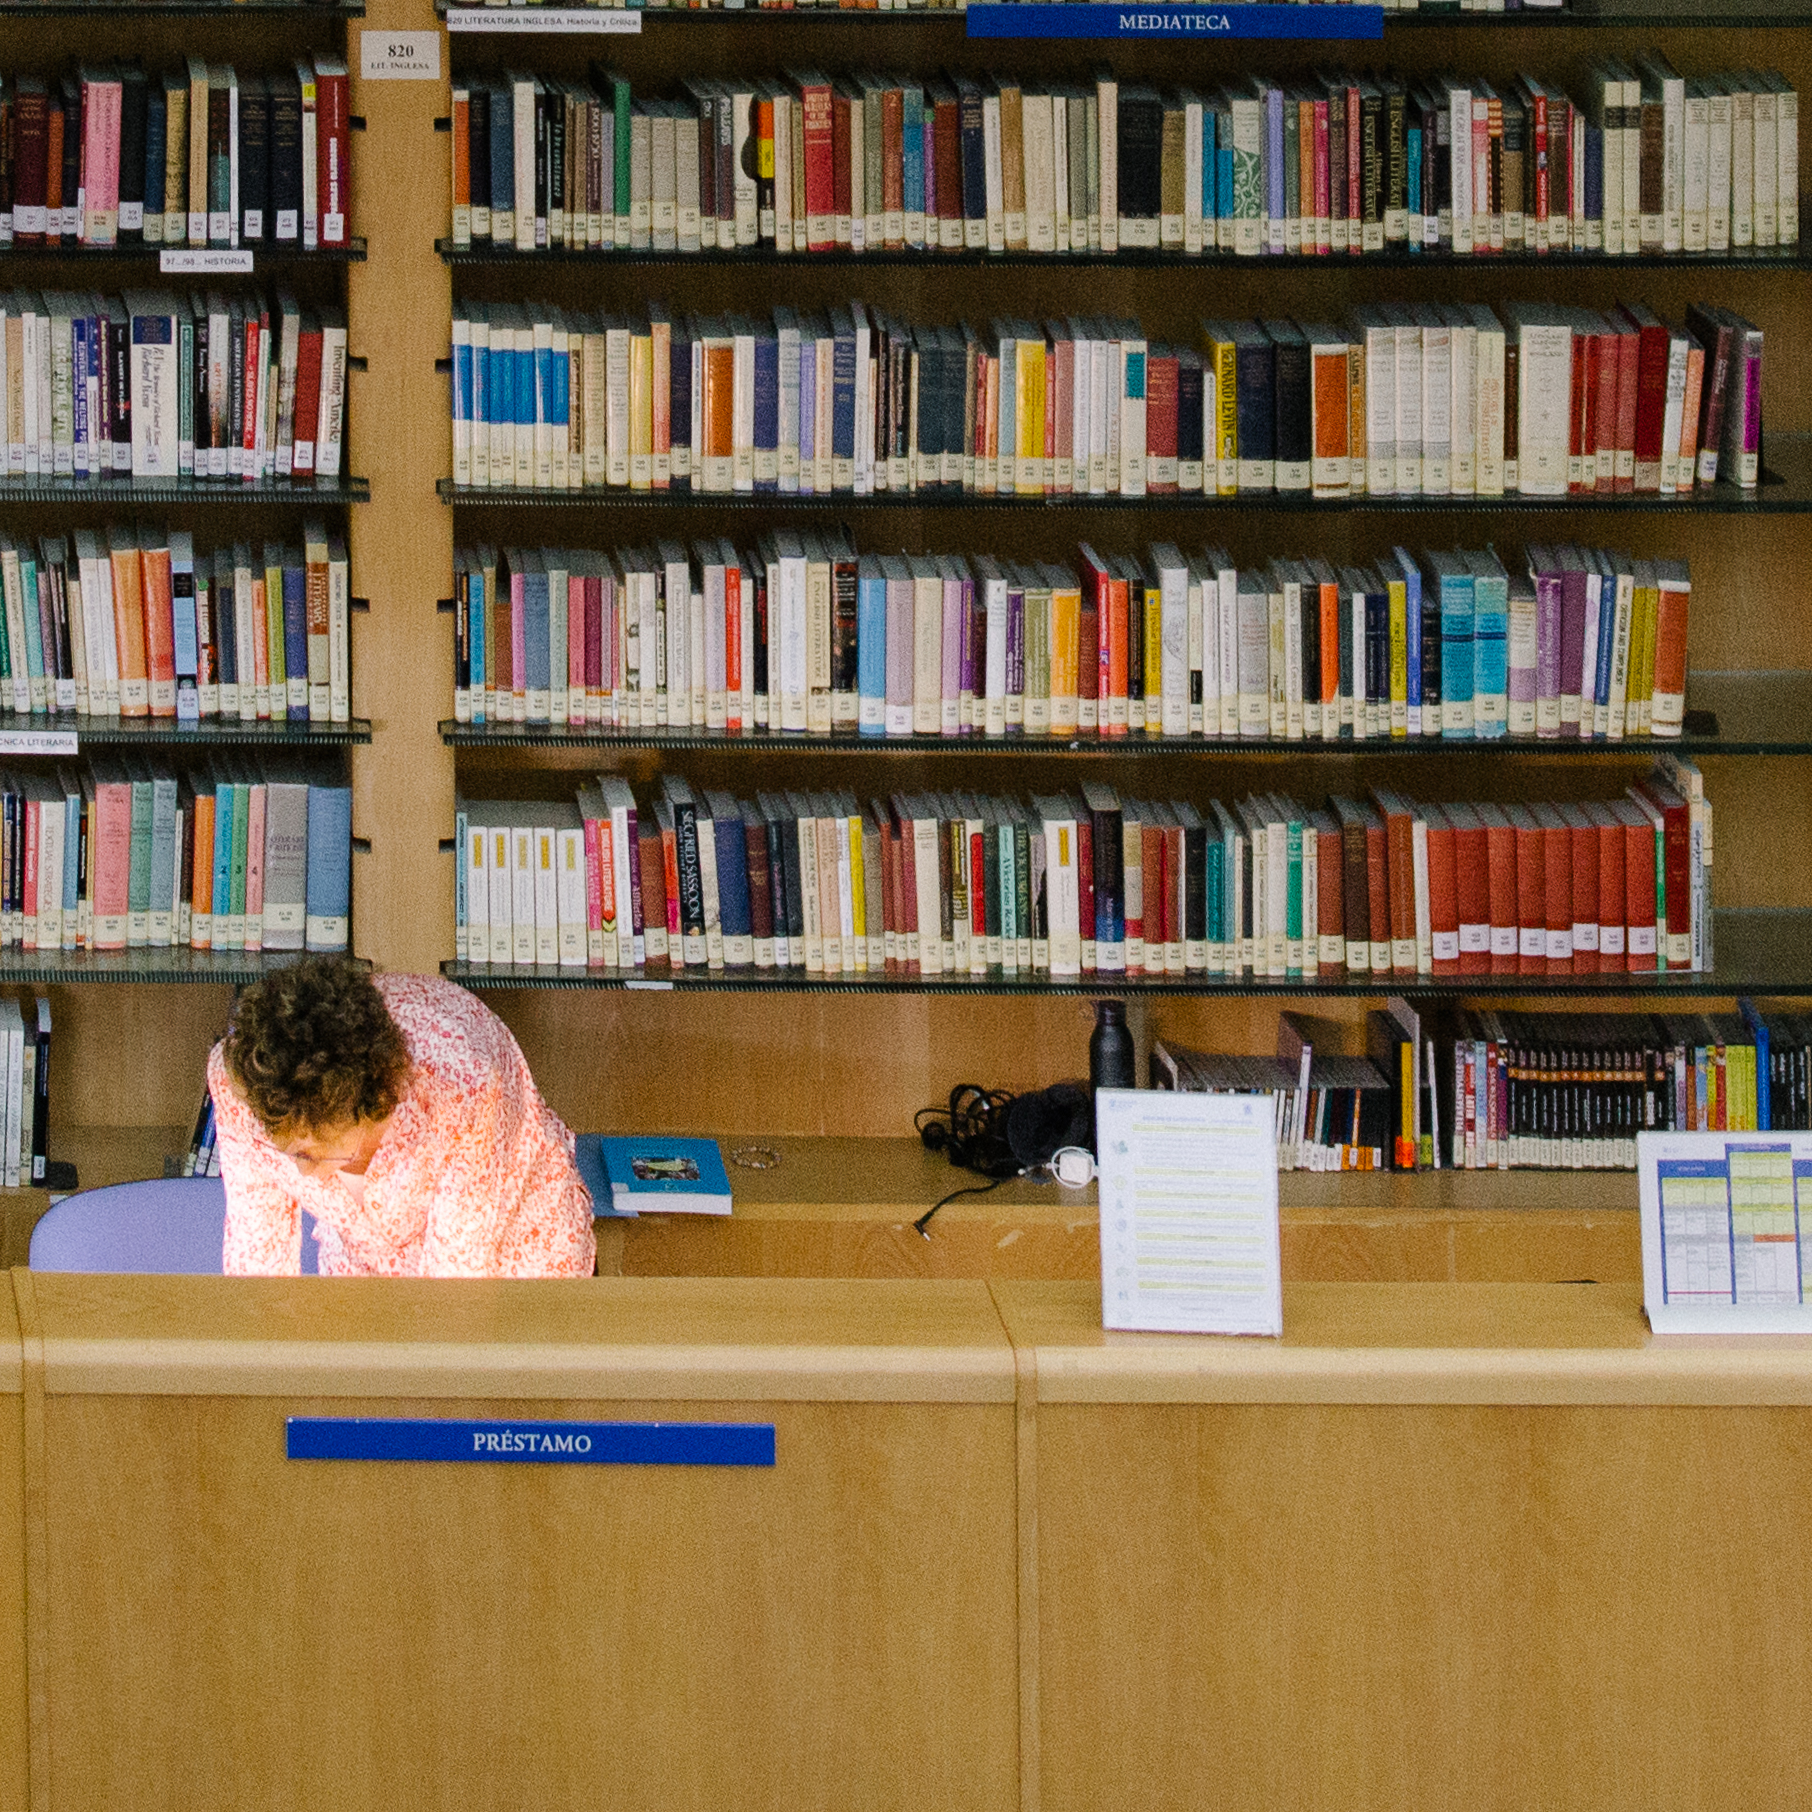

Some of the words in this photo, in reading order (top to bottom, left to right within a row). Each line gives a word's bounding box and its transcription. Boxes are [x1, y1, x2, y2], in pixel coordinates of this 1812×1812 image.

[464, 16, 520, 25] LITERATURA
[566, 16, 600, 26] Historia
[602, 18, 606, 27] y
[1119, 14, 1231, 30] MEDIATECA
[387, 44, 414, 58] 820
[390, 62, 430, 70] INGLESA
[1221, 401, 1235, 431] LEVIN
[27, 737, 74, 748] LITERARIA
[42, 825, 54, 864] TEXTUAL
[600, 829, 610, 865] ENGLISH
[682, 810, 697, 863] SIEGFRIED
[685, 865, 699, 918] SASSOON
[473, 1429, 592, 1453] PRÉSTAMO
